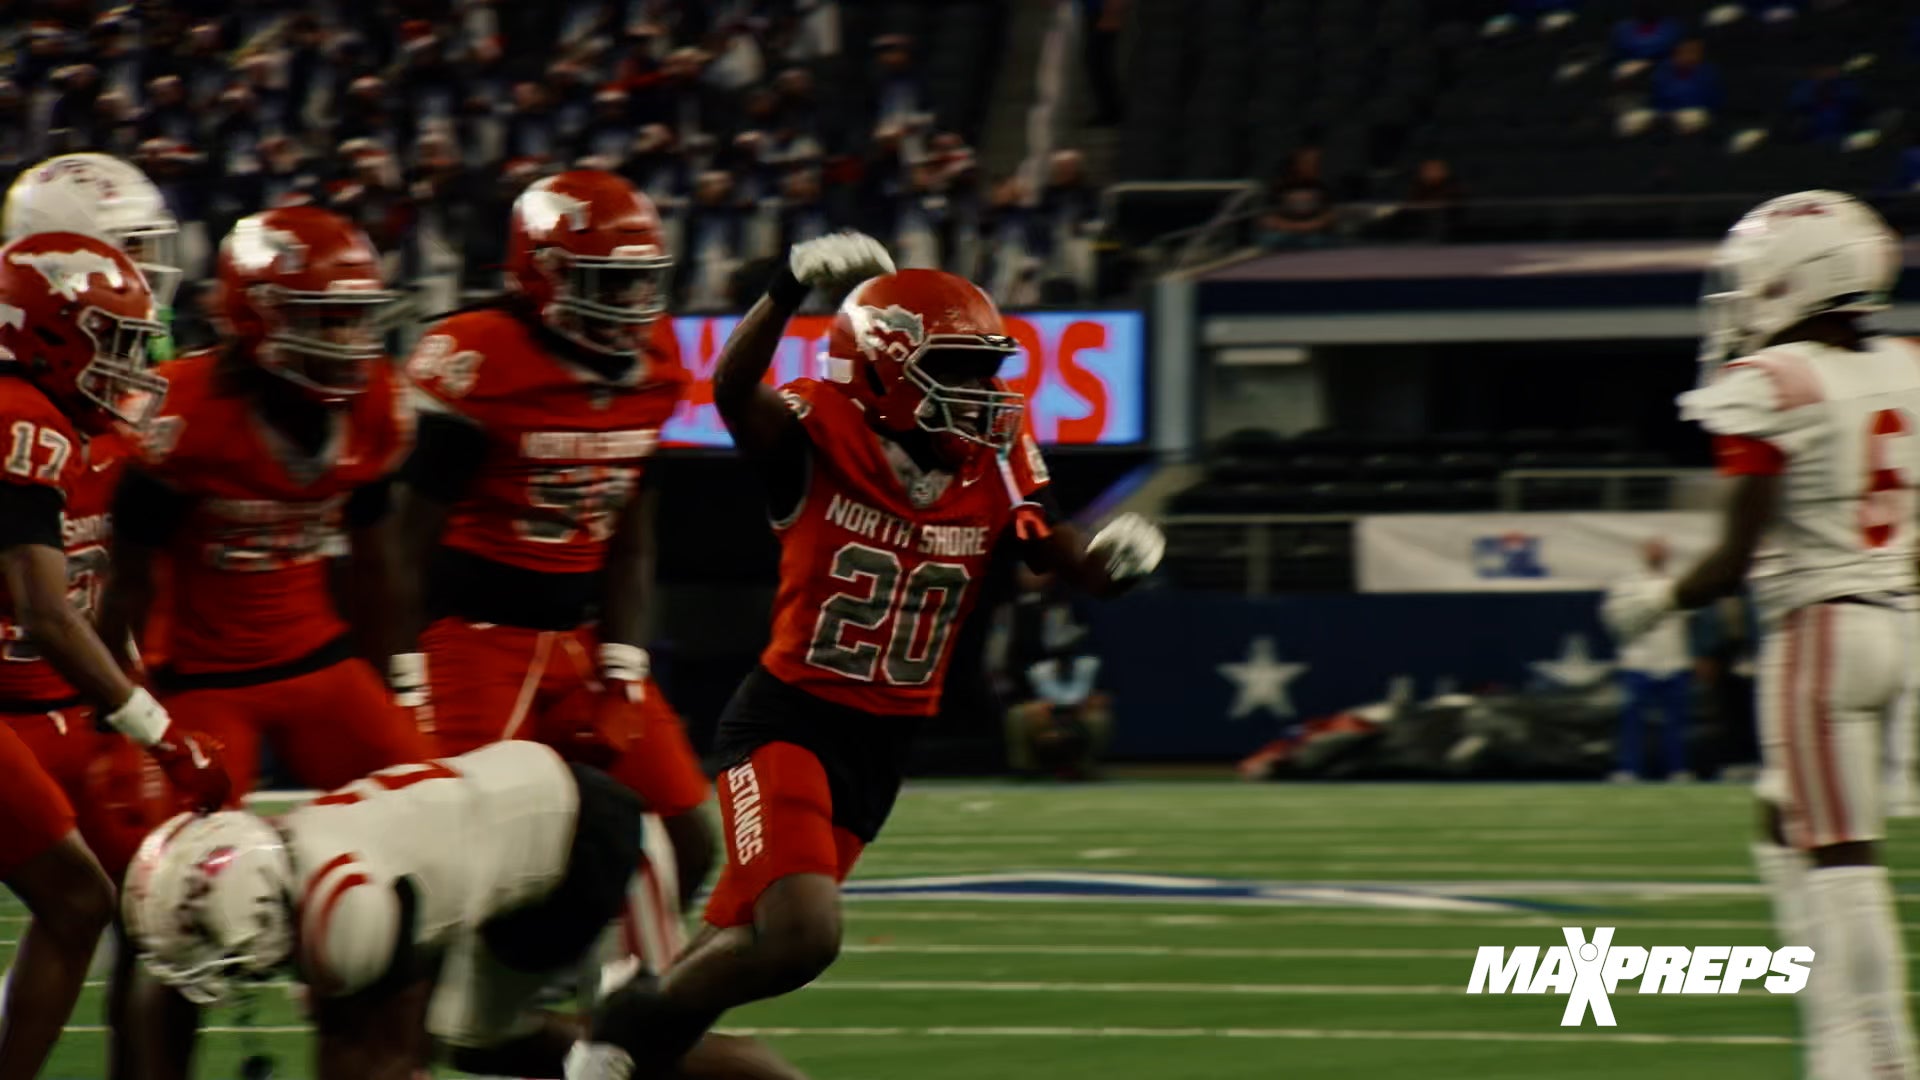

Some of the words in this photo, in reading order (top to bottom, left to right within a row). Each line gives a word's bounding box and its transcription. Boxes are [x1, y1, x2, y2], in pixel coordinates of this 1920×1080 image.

[4, 420, 72, 482] 17
[824, 492, 916, 548] NORTH
[917, 524, 990, 556] SHORE
[805, 541, 972, 685] 20
